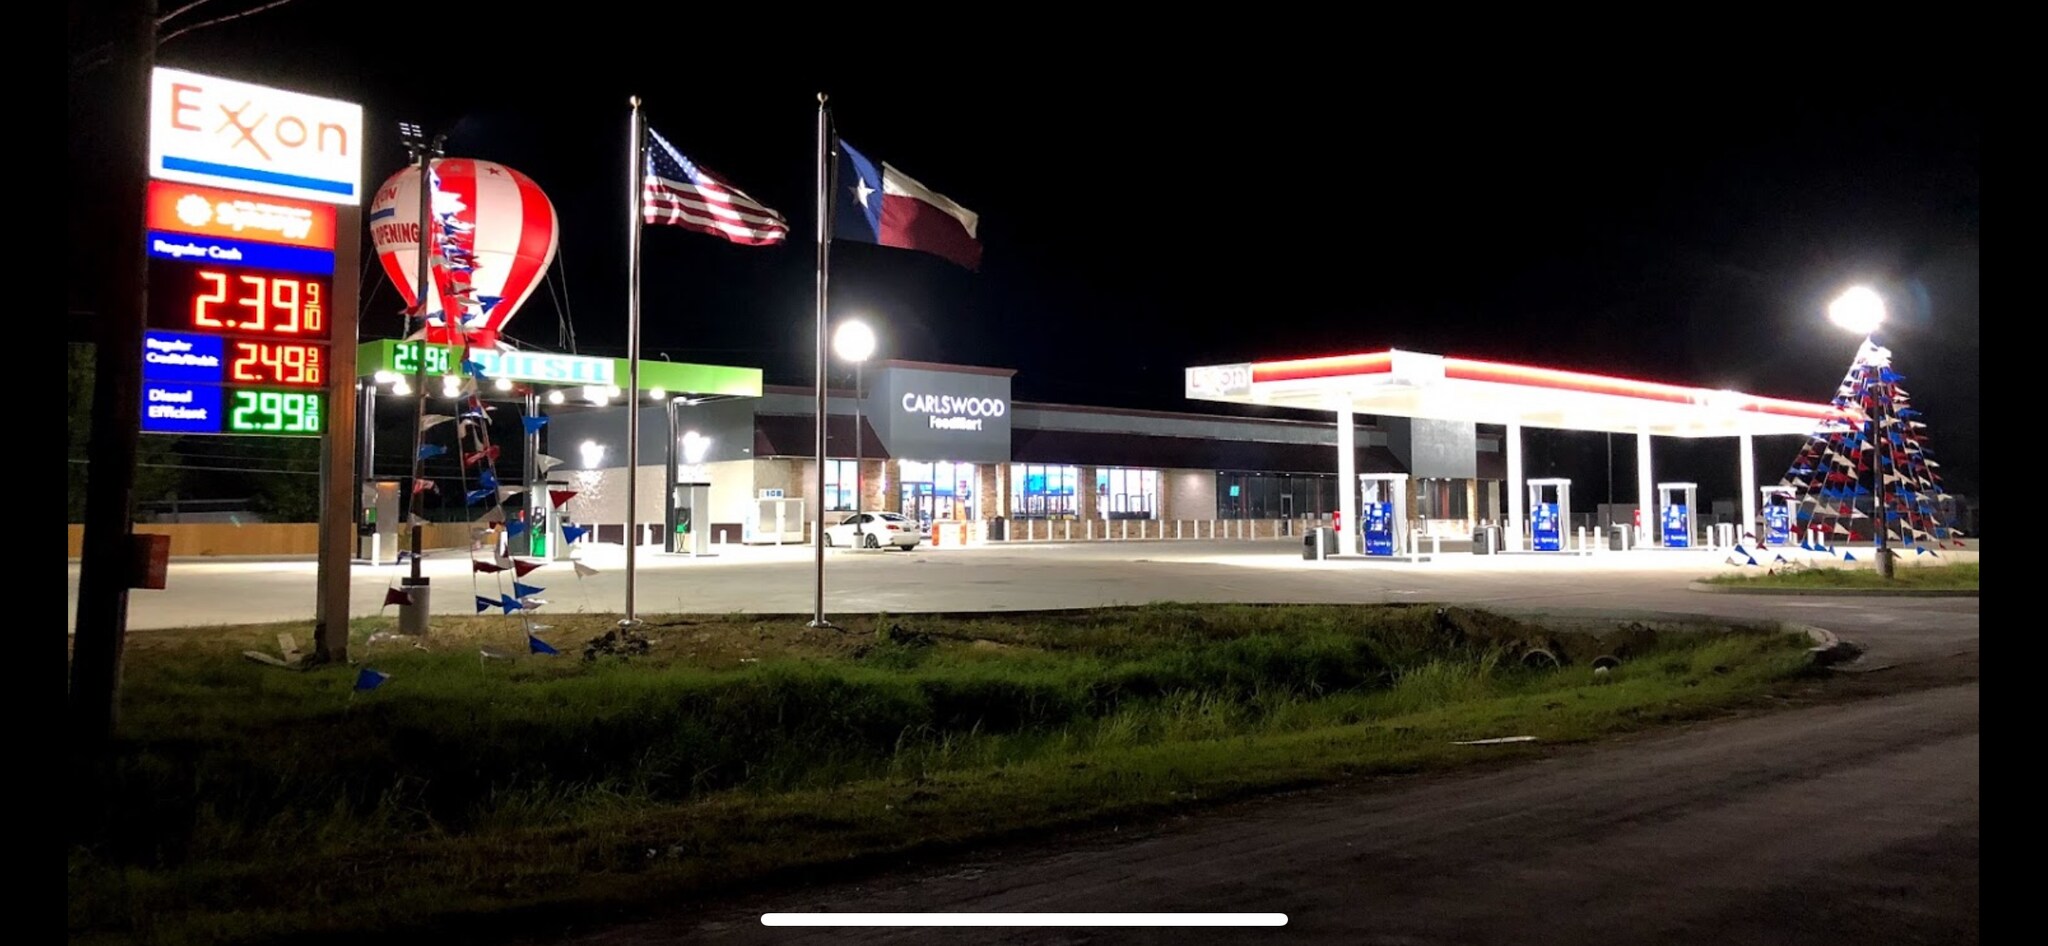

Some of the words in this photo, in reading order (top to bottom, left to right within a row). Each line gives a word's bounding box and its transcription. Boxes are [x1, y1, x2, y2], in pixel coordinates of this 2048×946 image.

[171, 83, 348, 162] Exxon
[376, 222, 420, 246] OPENING
[153, 239, 207, 257] Regular
[209, 245, 243, 261] Cash
[195, 271, 300, 333] 2.39
[234, 342, 305, 383] 2.49
[477, 353, 607, 382] DIESEL
[149, 388, 193, 403] Diesel
[902, 392, 1006, 417] CARLSWOOD
[148, 404, 207, 420] Efficient
[233, 391, 305, 432] 2.99
